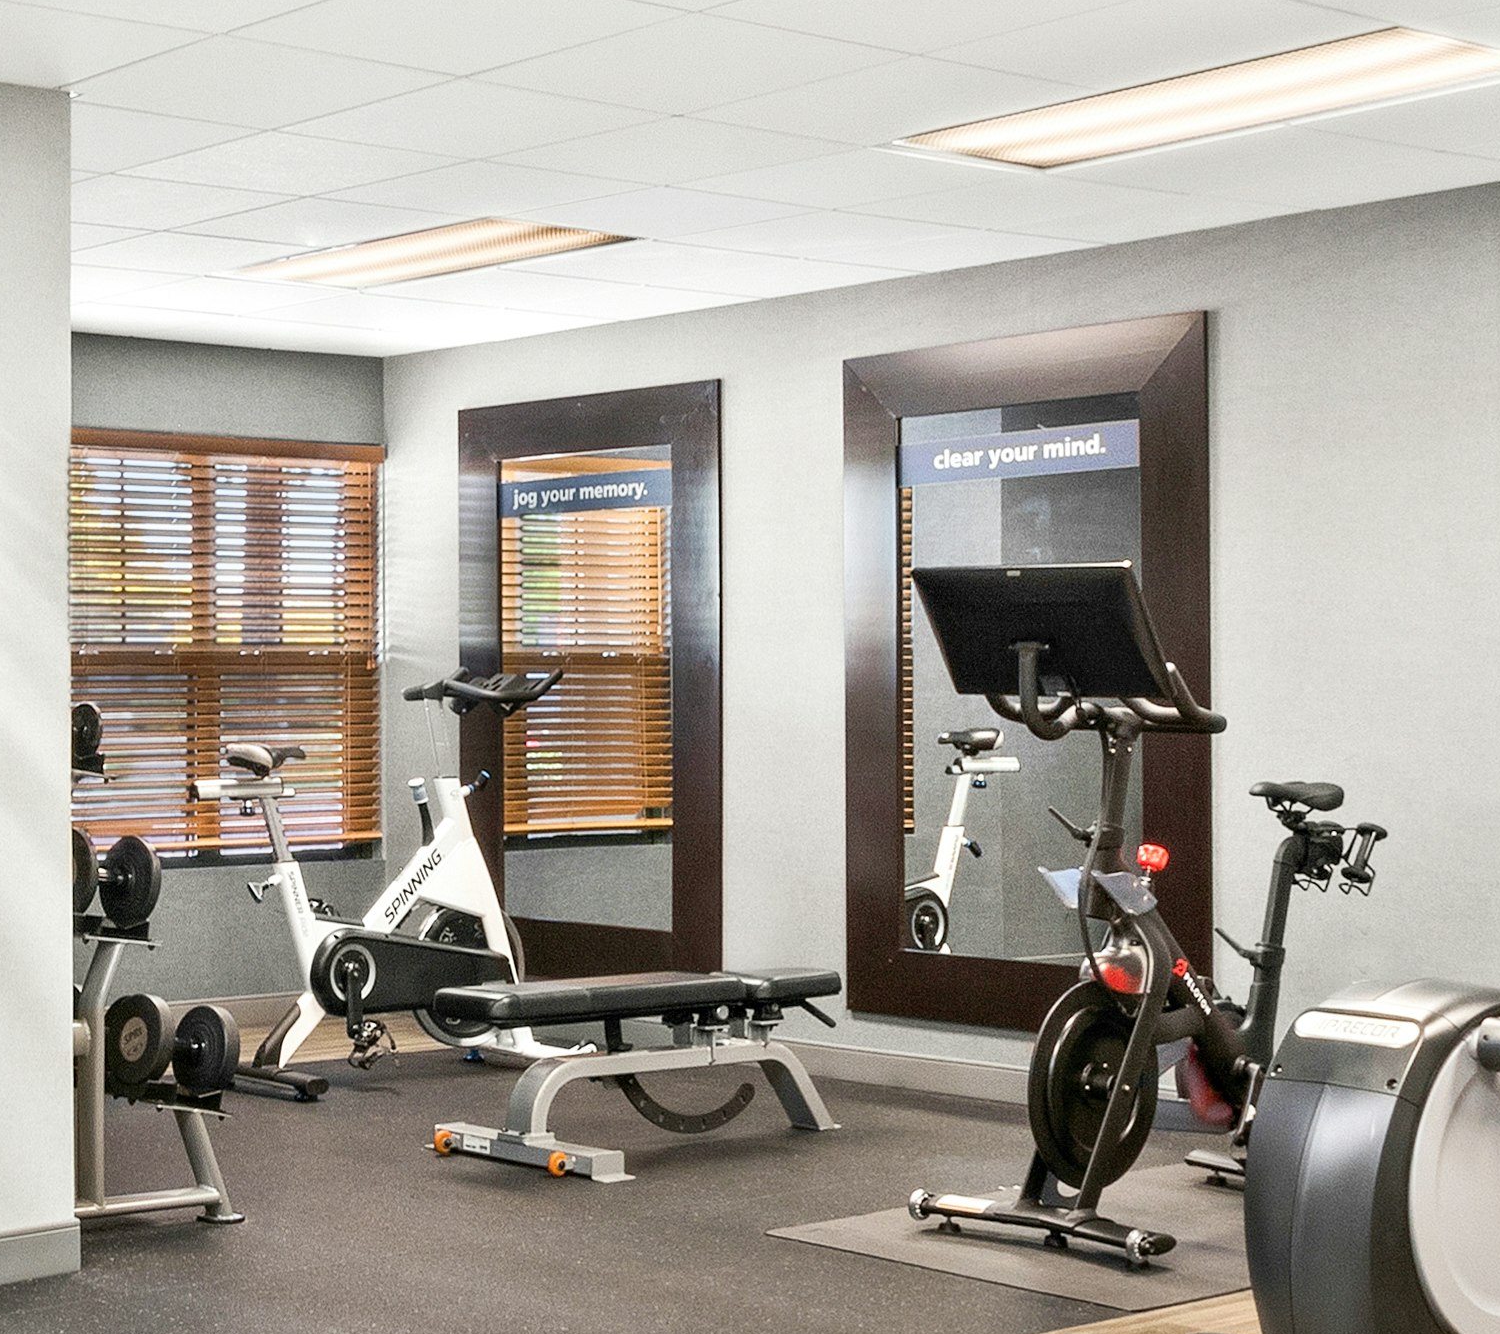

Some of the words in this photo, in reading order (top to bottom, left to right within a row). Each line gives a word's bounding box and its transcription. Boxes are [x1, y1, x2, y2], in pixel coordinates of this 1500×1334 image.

[933, 449, 984, 470] clear
[988, 444, 1038, 469] your
[1042, 433, 1106, 460] mind.
[513, 488, 538, 510] jog
[541, 487, 576, 508] your
[579, 481, 649, 501] memory.
[384, 848, 443, 924] SPINNING
[1183, 971, 1212, 1015] PELOTON
